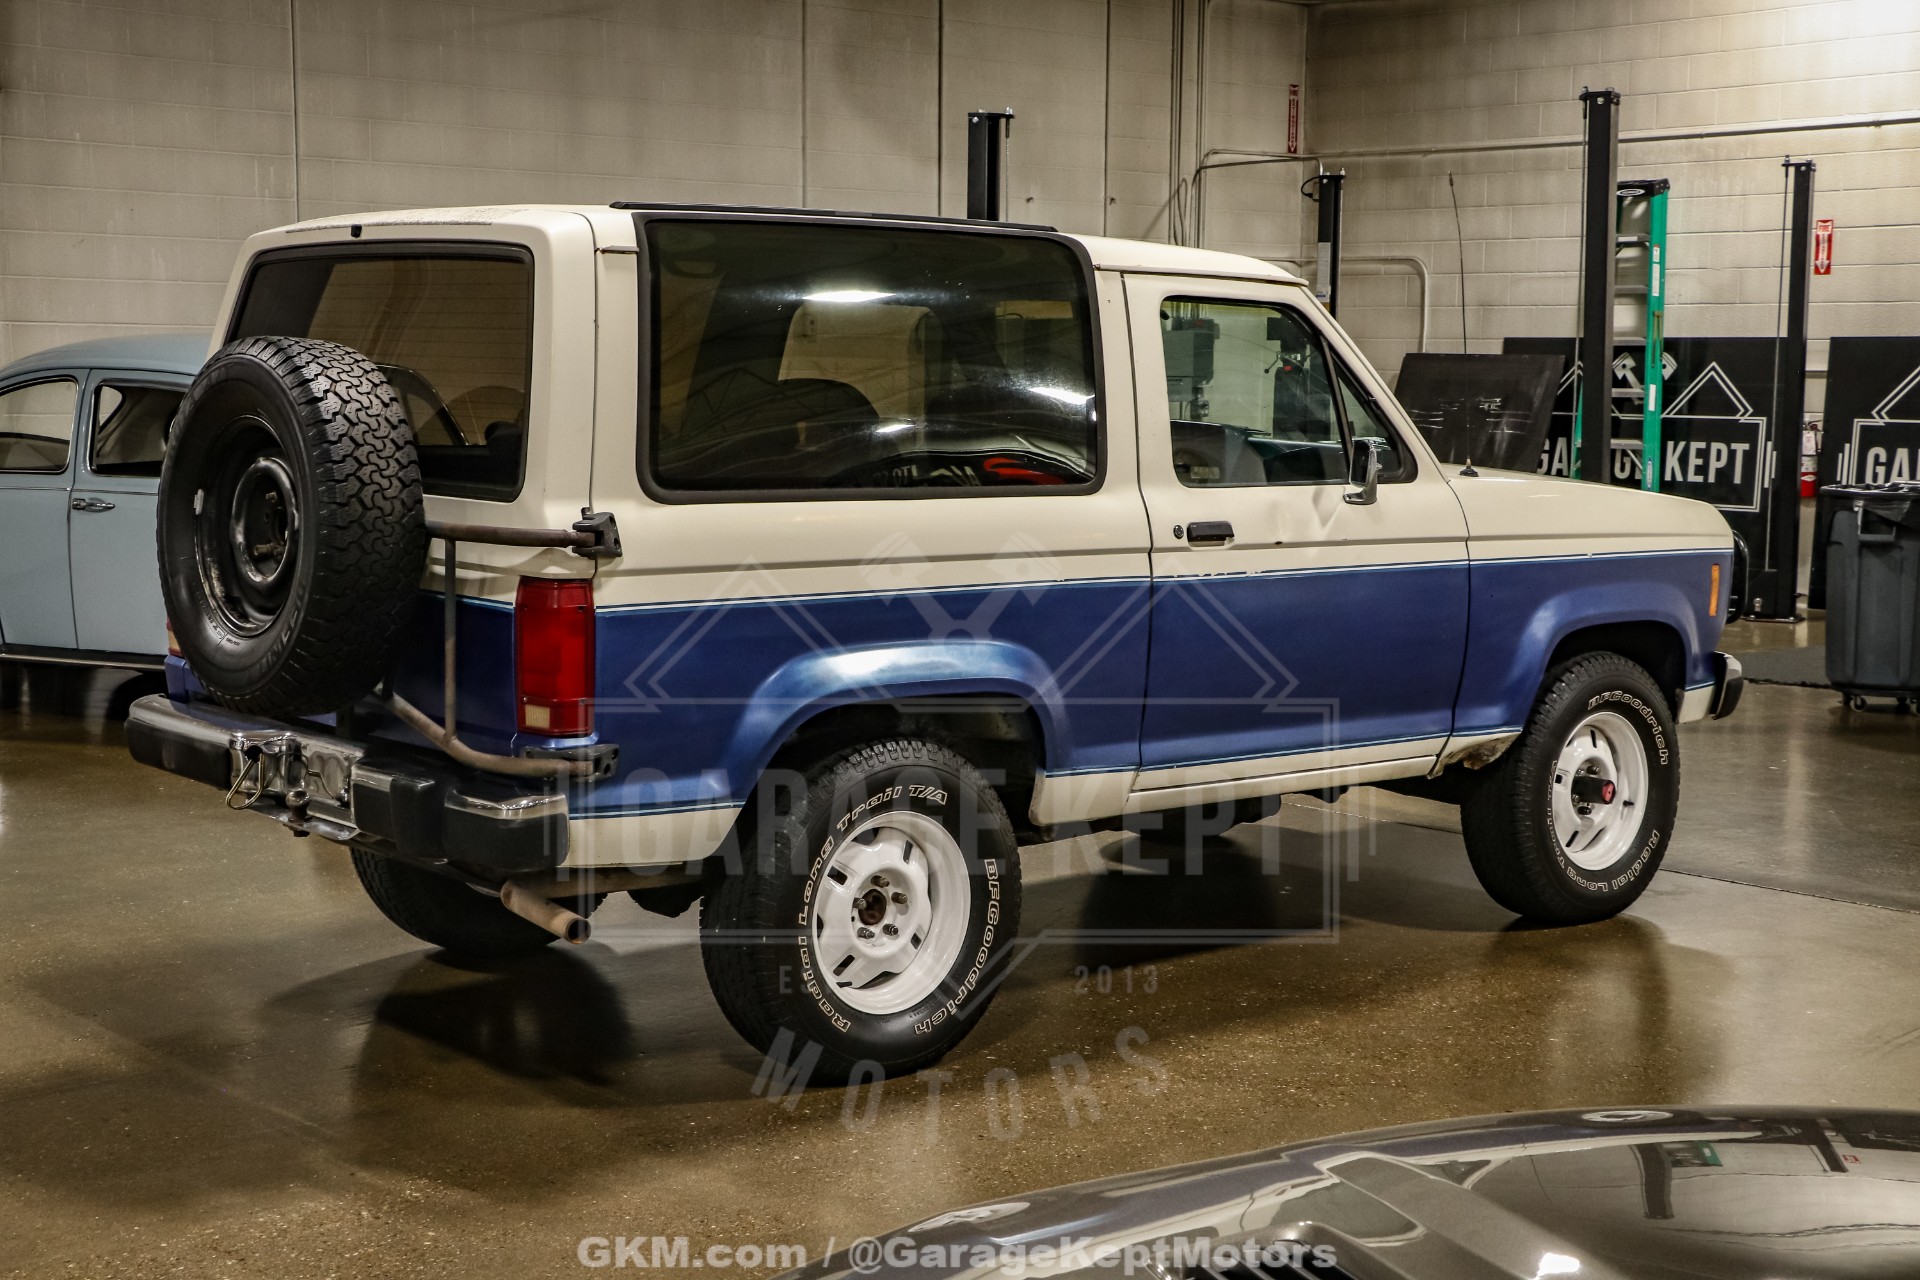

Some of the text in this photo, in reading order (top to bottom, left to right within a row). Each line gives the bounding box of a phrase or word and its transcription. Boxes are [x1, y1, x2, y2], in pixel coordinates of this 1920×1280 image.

[1664, 440, 1750, 484] KEPT
[1865, 446, 1920, 486] GA
[1588, 690, 1669, 765] BFGoodrich
[1567, 866, 1609, 892] Long
[1612, 829, 1660, 890] Radial
[798, 784, 948, 1032] Radial Long Trail T/A
[914, 858, 1000, 1035] BFGoodrich
